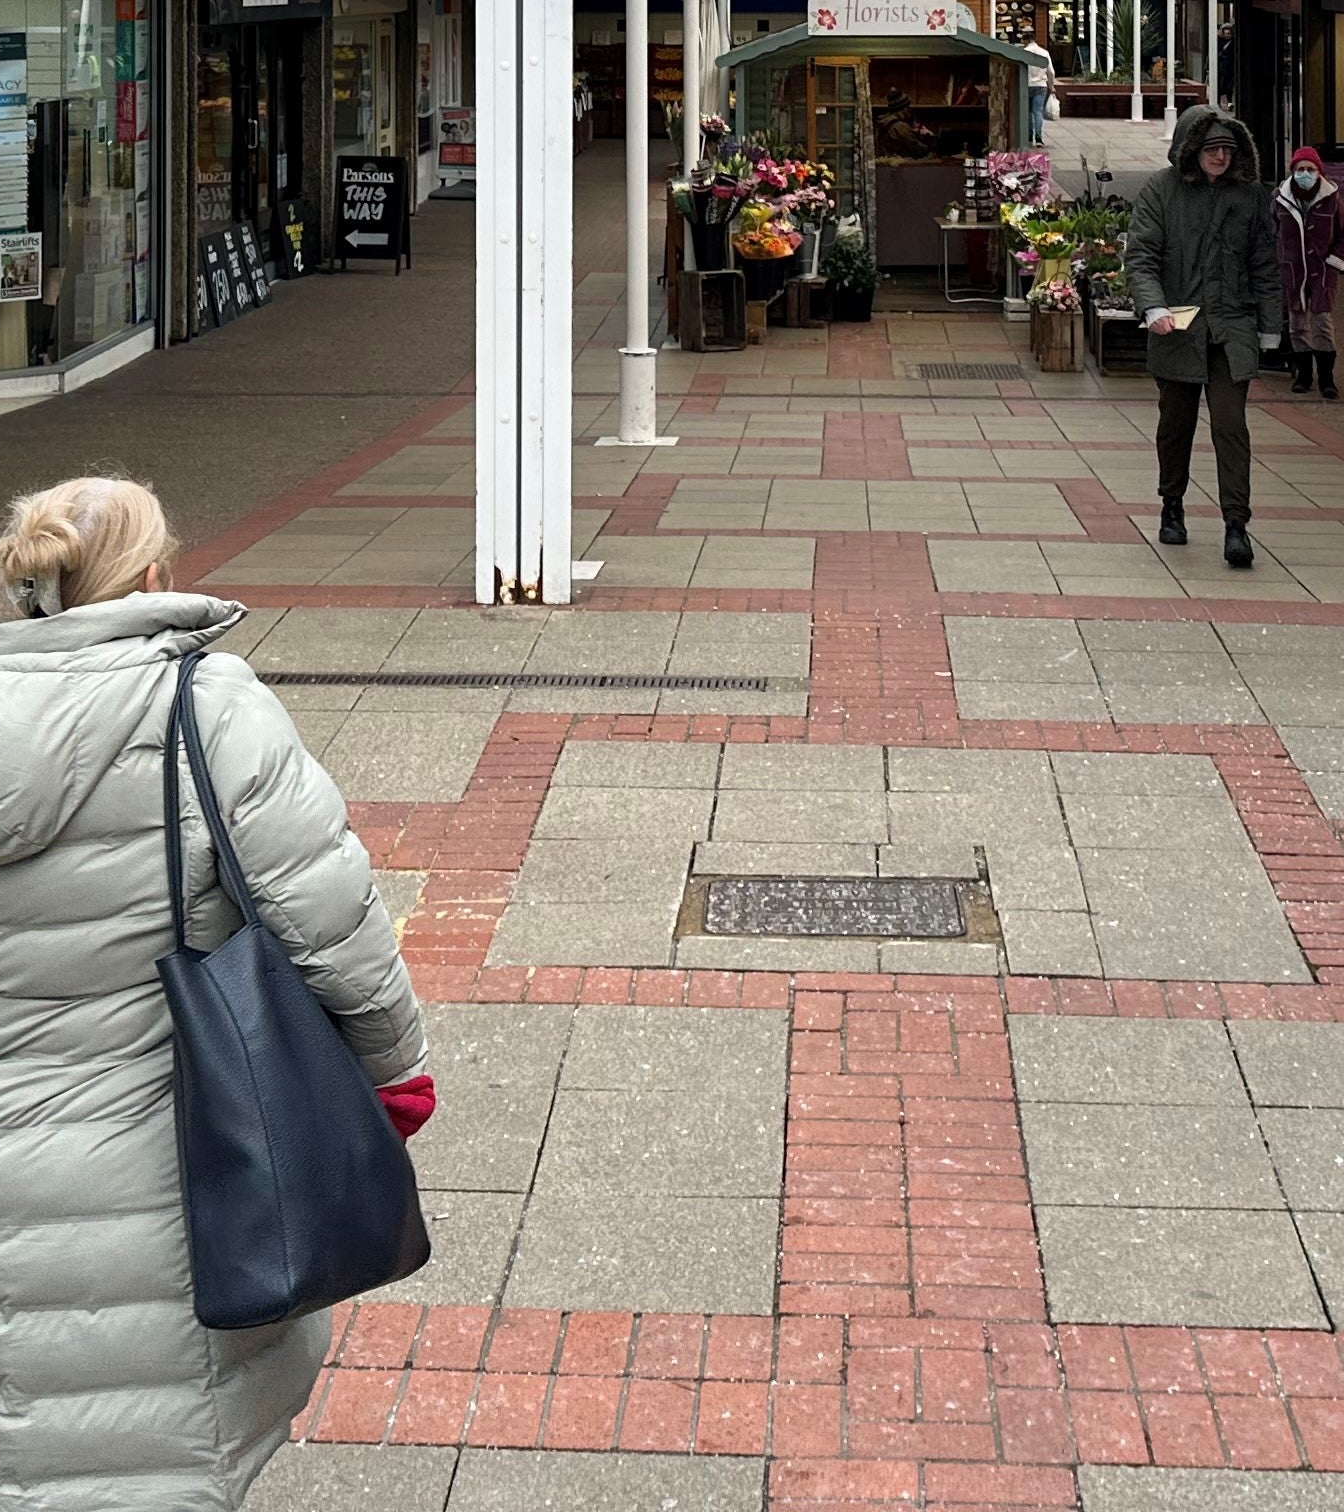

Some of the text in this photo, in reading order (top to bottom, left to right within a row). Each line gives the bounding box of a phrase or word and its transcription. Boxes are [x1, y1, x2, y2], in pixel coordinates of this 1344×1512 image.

[342, 168, 395, 182] Parsons
[345, 184, 388, 202] THIS
[343, 202, 385, 221] WAY
[1, 236, 40, 249] Stairlifts
